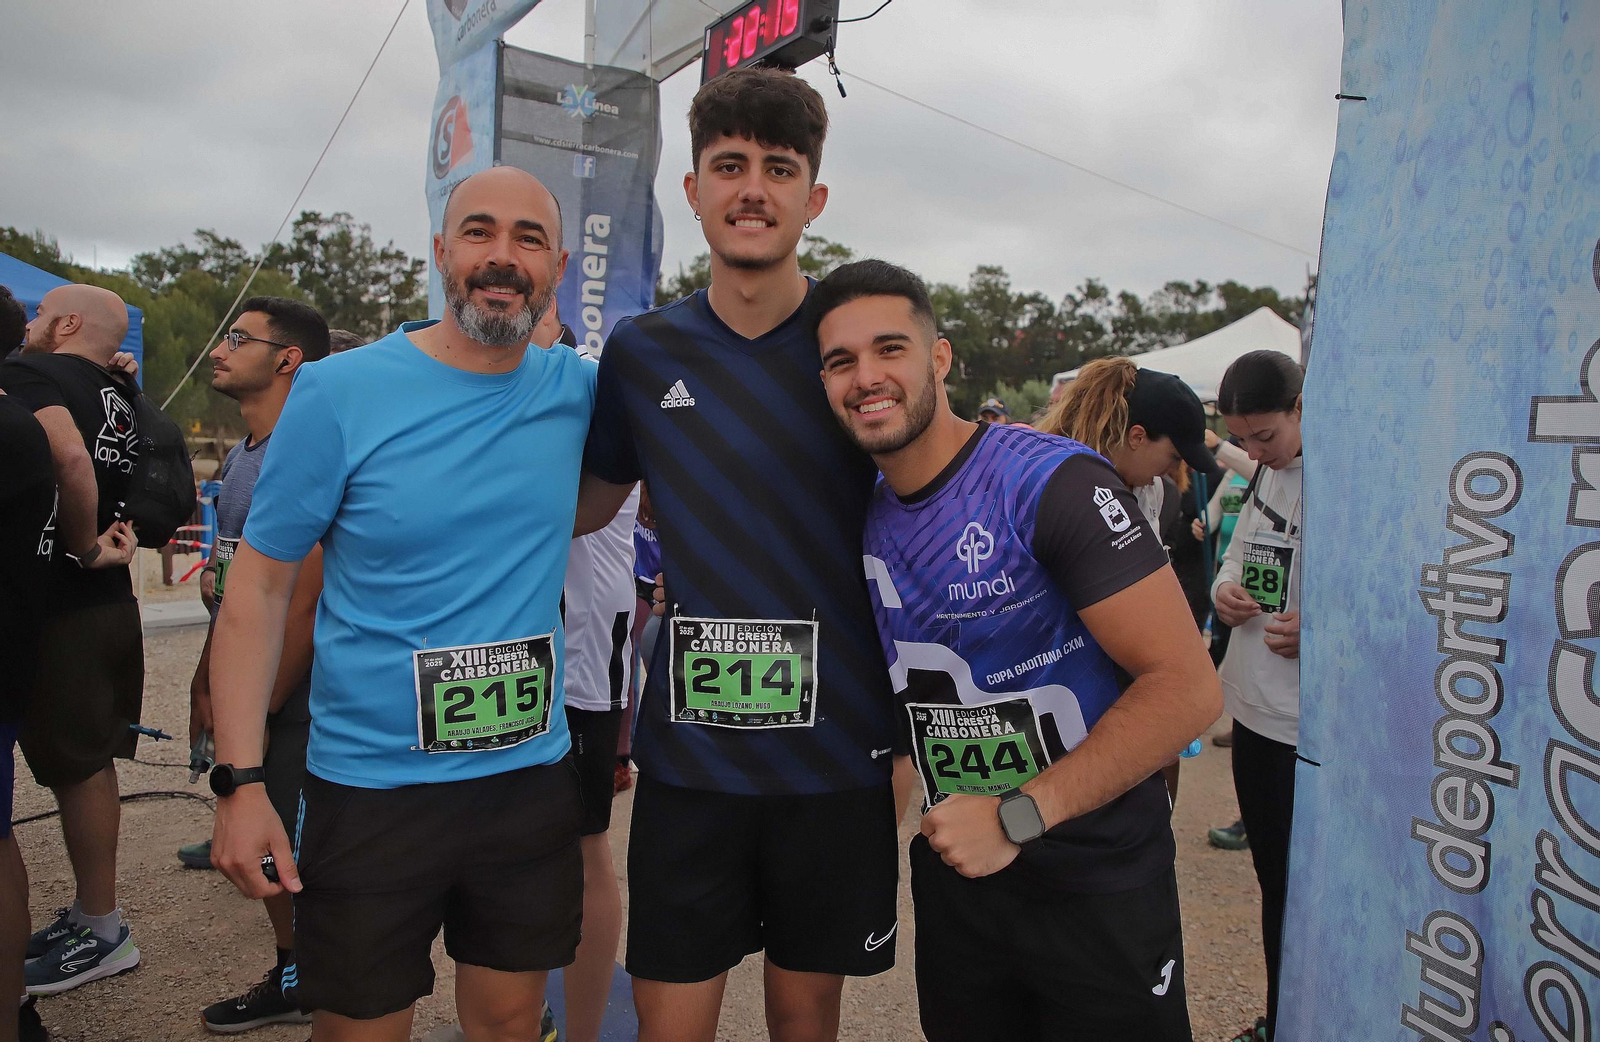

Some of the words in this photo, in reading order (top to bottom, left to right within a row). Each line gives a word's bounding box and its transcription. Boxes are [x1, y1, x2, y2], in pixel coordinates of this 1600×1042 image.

[556, 91, 573, 104] La
[660, 397, 696, 409] adidas
[948, 570, 1015, 600] mundi
[1241, 565, 1278, 593] 28
[936, 610, 987, 619] MANTENIMIENTO
[700, 623, 735, 640] XIII
[738, 624, 781, 633] EDICIÓN
[737, 632, 782, 641] CRESTA
[690, 639, 793, 653] CARBONERA
[425, 660, 443, 668] 2025
[450, 648, 486, 668] XIII
[488, 643, 528, 656] EDICIÓN
[488, 650, 529, 664] CRESTA
[986, 668, 1015, 685] COPA
[1014, 649, 1063, 675] GADITANA
[1063, 635, 1085, 655] CXM
[440, 657, 539, 681] CARBONERA
[691, 657, 794, 696] 214
[1411, 451, 1523, 894] deportivo
[443, 675, 538, 724] 215
[929, 709, 956, 726] XIII
[955, 706, 996, 718] EDICIÓN
[957, 714, 1000, 727] CRESTA
[447, 728, 470, 737] ARAUJO
[926, 721, 1016, 738] CARBONERA
[932, 740, 1028, 779] 244
[1401, 910, 1485, 1042] lub
